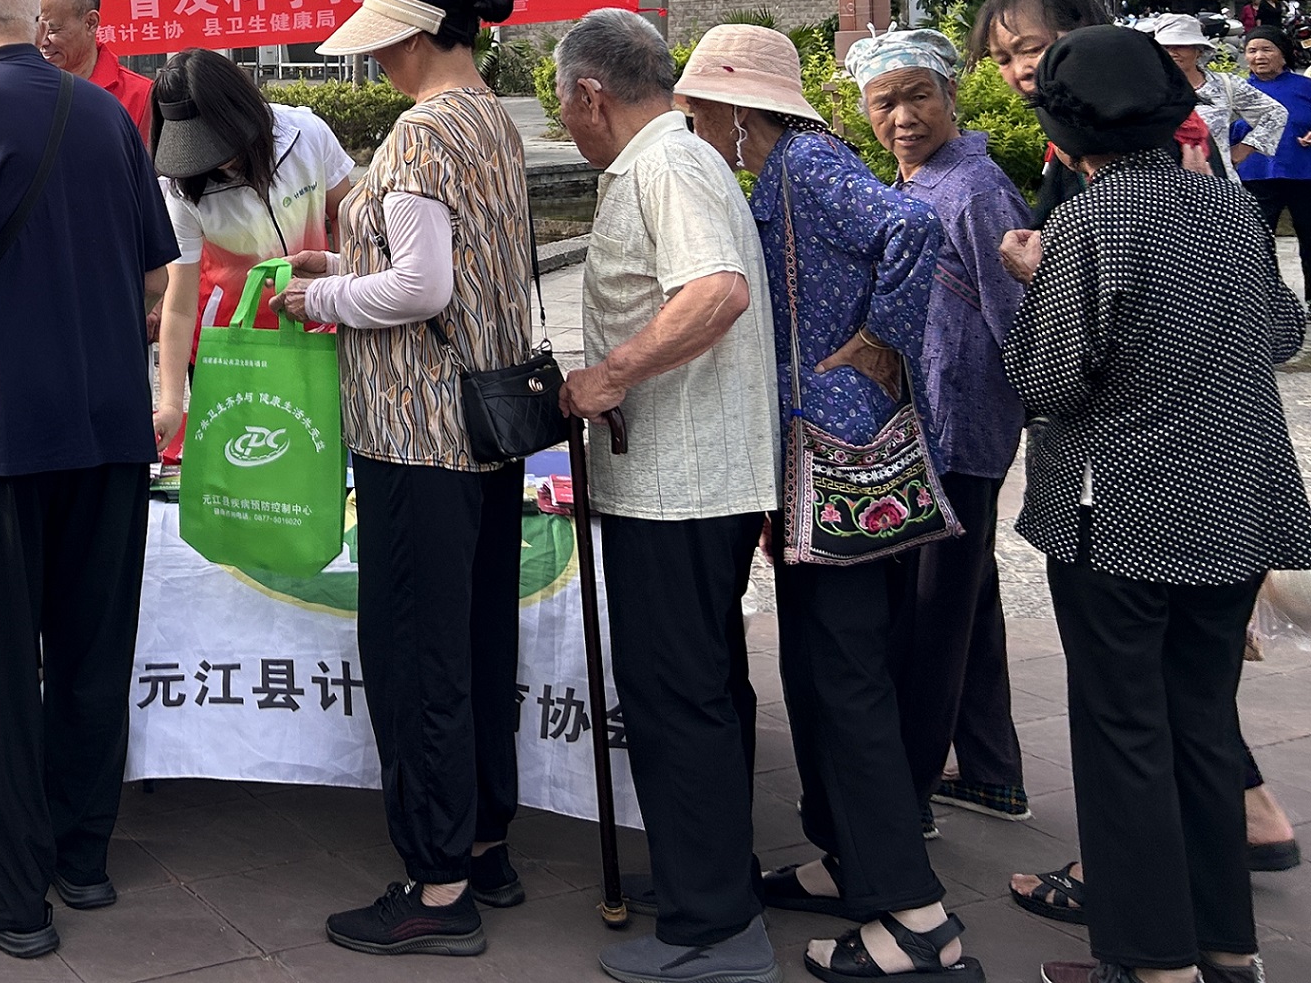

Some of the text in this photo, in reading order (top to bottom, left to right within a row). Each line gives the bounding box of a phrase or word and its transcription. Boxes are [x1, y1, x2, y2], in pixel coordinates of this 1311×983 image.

[202, 10, 337, 37] 县卫生健康局
[202, 494, 313, 516] 元江县疾病预防控制中心
